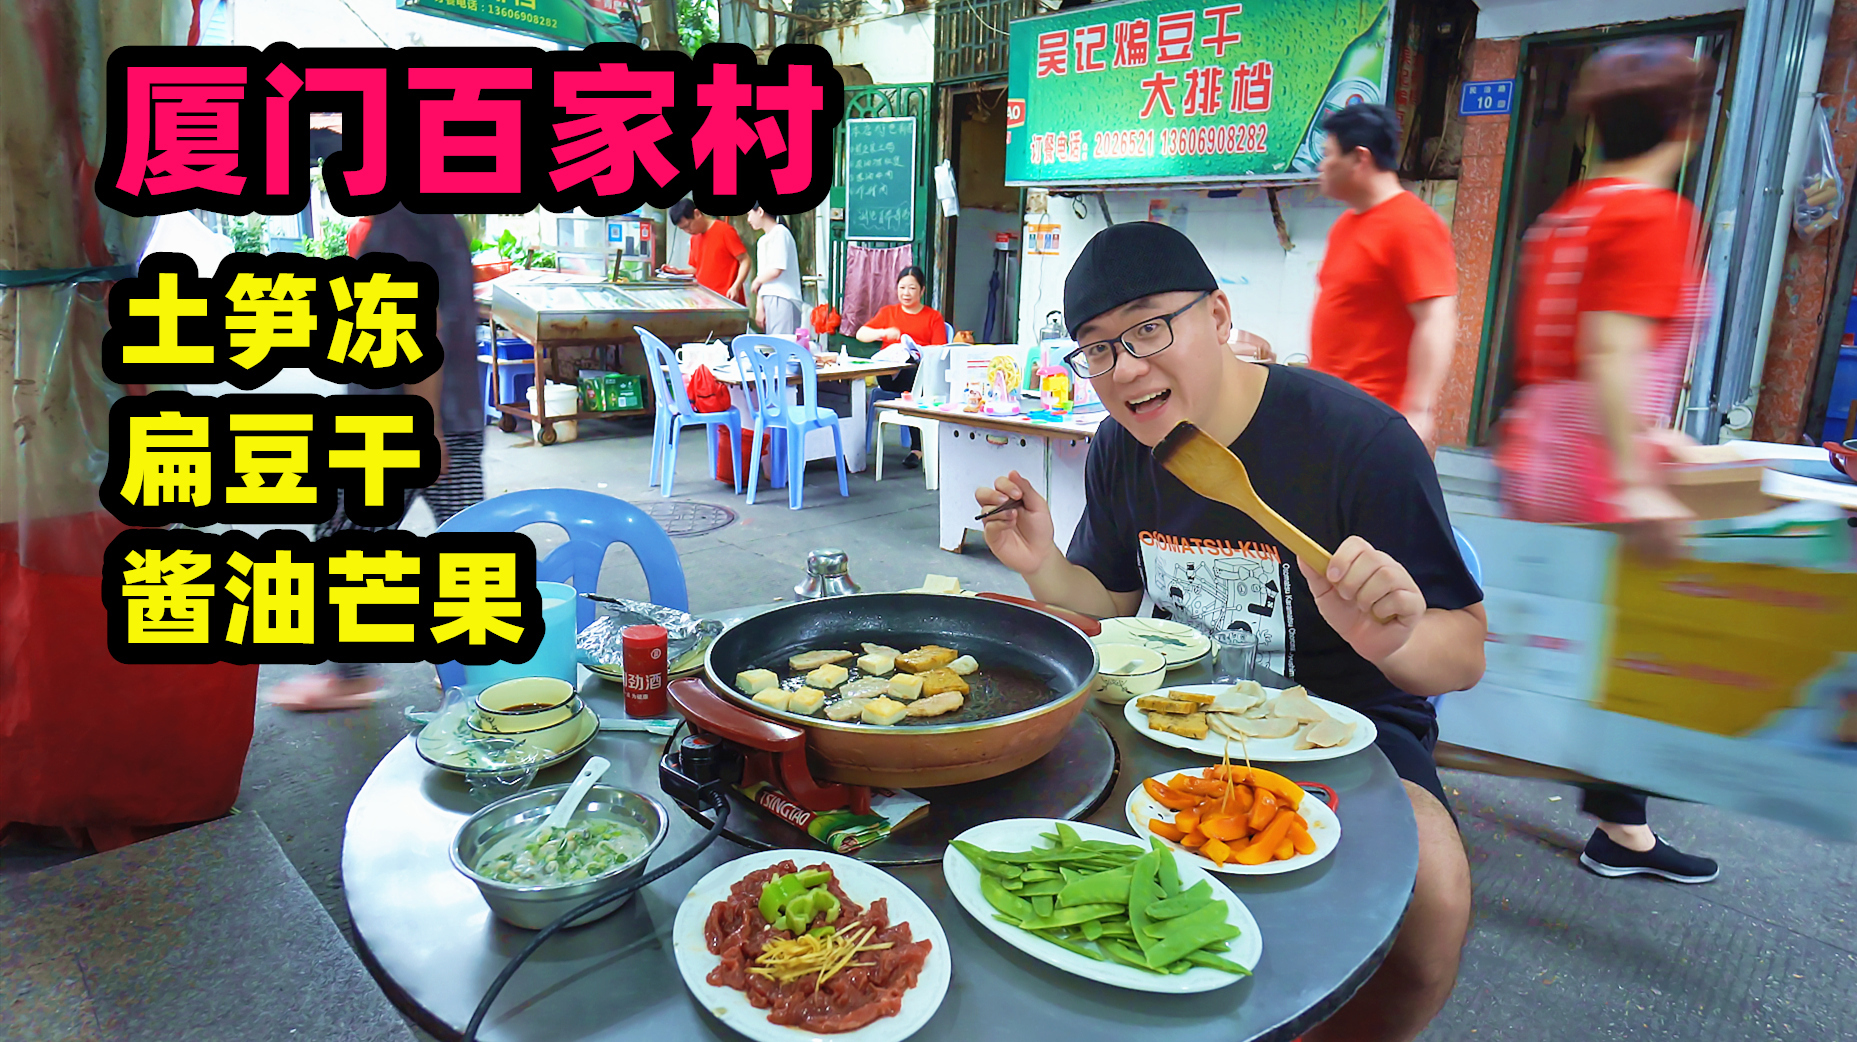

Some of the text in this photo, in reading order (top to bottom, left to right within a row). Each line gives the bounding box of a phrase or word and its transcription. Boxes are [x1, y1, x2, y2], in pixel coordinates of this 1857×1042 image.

[1036, 4, 1242, 78] 吴记煸豆干
[1139, 60, 1273, 119] 大排档
[1093, 128, 1154, 158] 2026521
[1160, 122, 1268, 156] 13606908282
[624, 672, 662, 691] 劲酒
[759, 791, 811, 826] TSINGTAO
